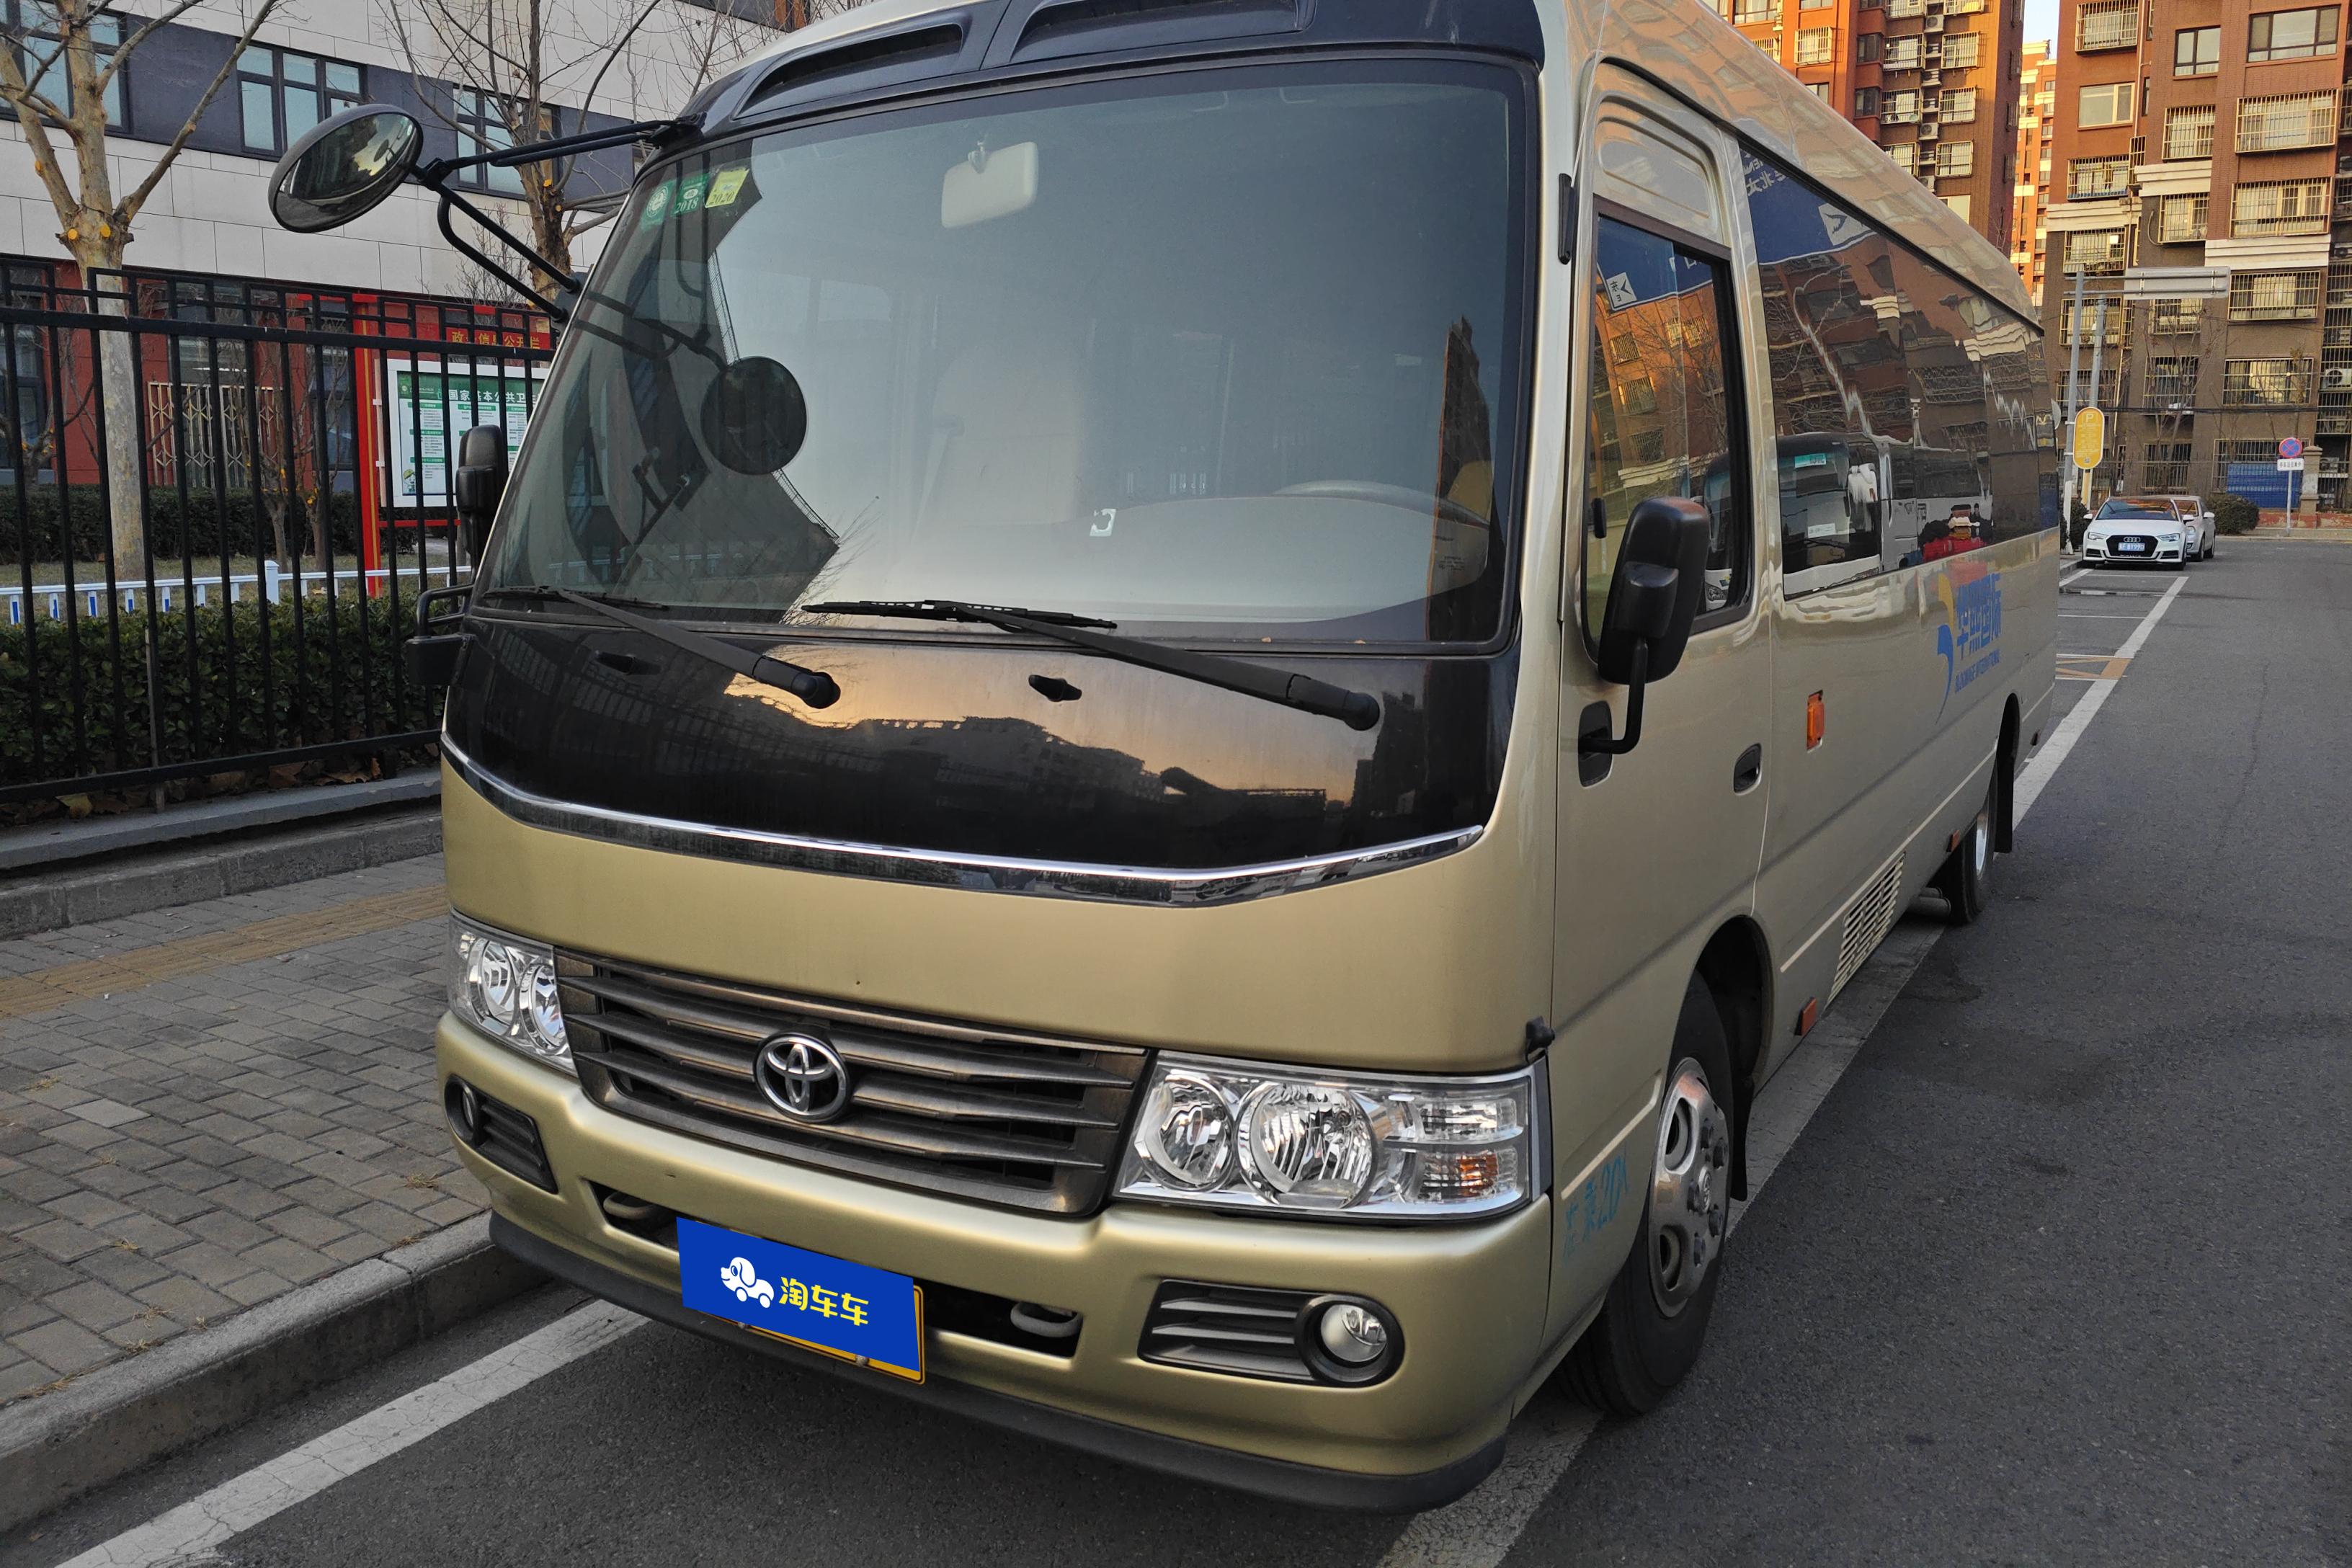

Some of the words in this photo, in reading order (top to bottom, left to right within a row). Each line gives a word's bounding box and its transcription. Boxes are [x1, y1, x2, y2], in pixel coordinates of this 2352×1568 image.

[674, 197, 699, 214] 2018
[708, 191, 735, 205] 2020
[452, 331, 540, 349] 政信公开栏
